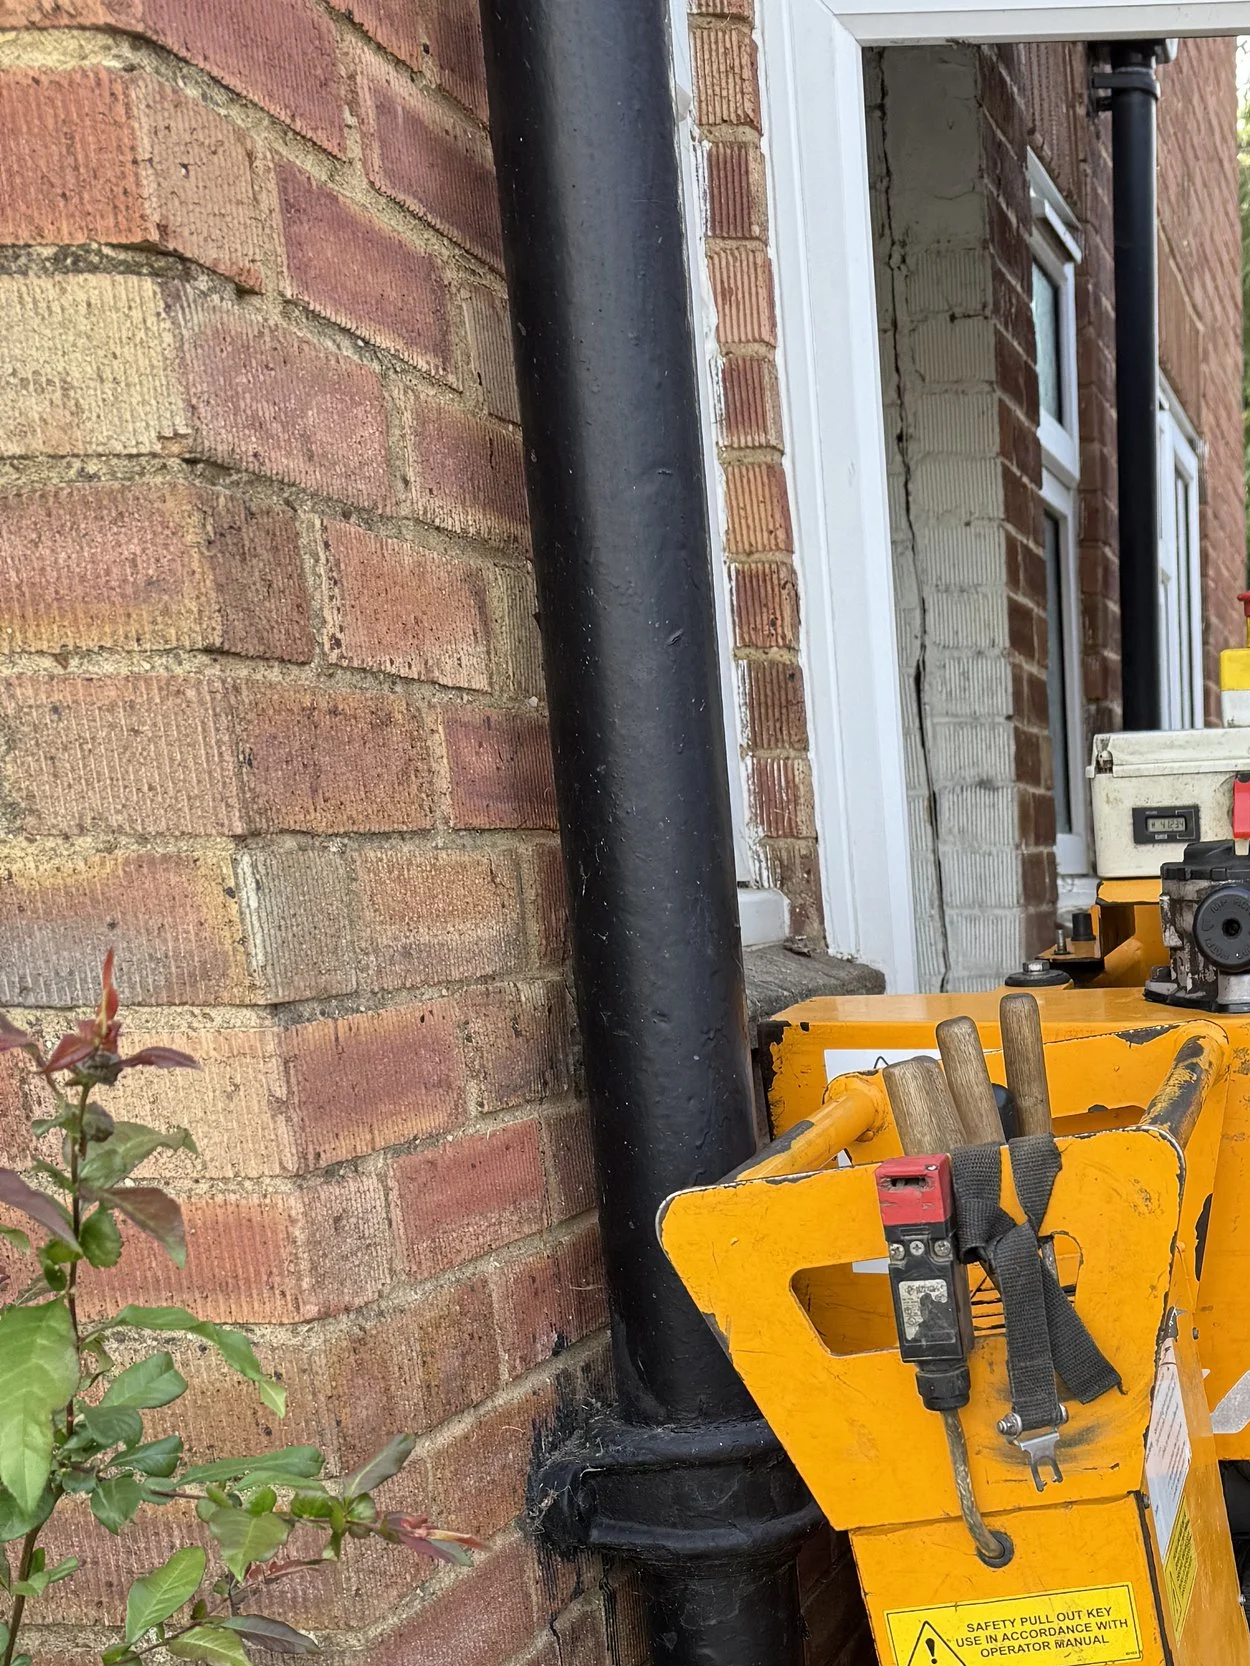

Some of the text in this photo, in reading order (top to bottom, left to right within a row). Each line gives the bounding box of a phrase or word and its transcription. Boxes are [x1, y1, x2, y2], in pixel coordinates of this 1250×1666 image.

[956, 1618, 1128, 1647] USE IN ACCORDANCE WITH
[967, 1606, 1112, 1633] SAFETY PULL OUT KEY
[980, 1634, 1109, 1657] OPERATOR MANUAL
